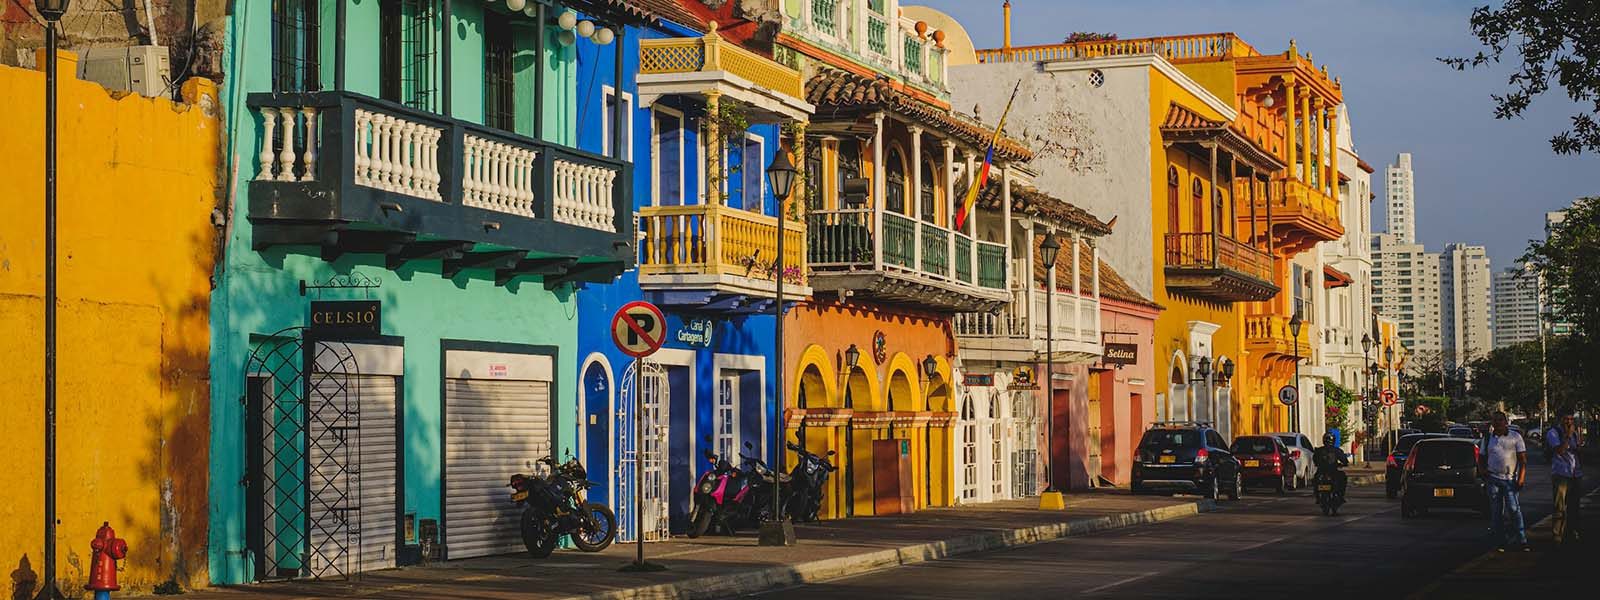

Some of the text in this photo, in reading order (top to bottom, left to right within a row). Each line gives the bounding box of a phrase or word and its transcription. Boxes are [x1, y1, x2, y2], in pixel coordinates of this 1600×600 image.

[627, 313, 655, 346] P
[690, 319, 704, 331] Canal
[677, 329, 704, 344] Cartagena
[1107, 348, 1135, 359] Selina
